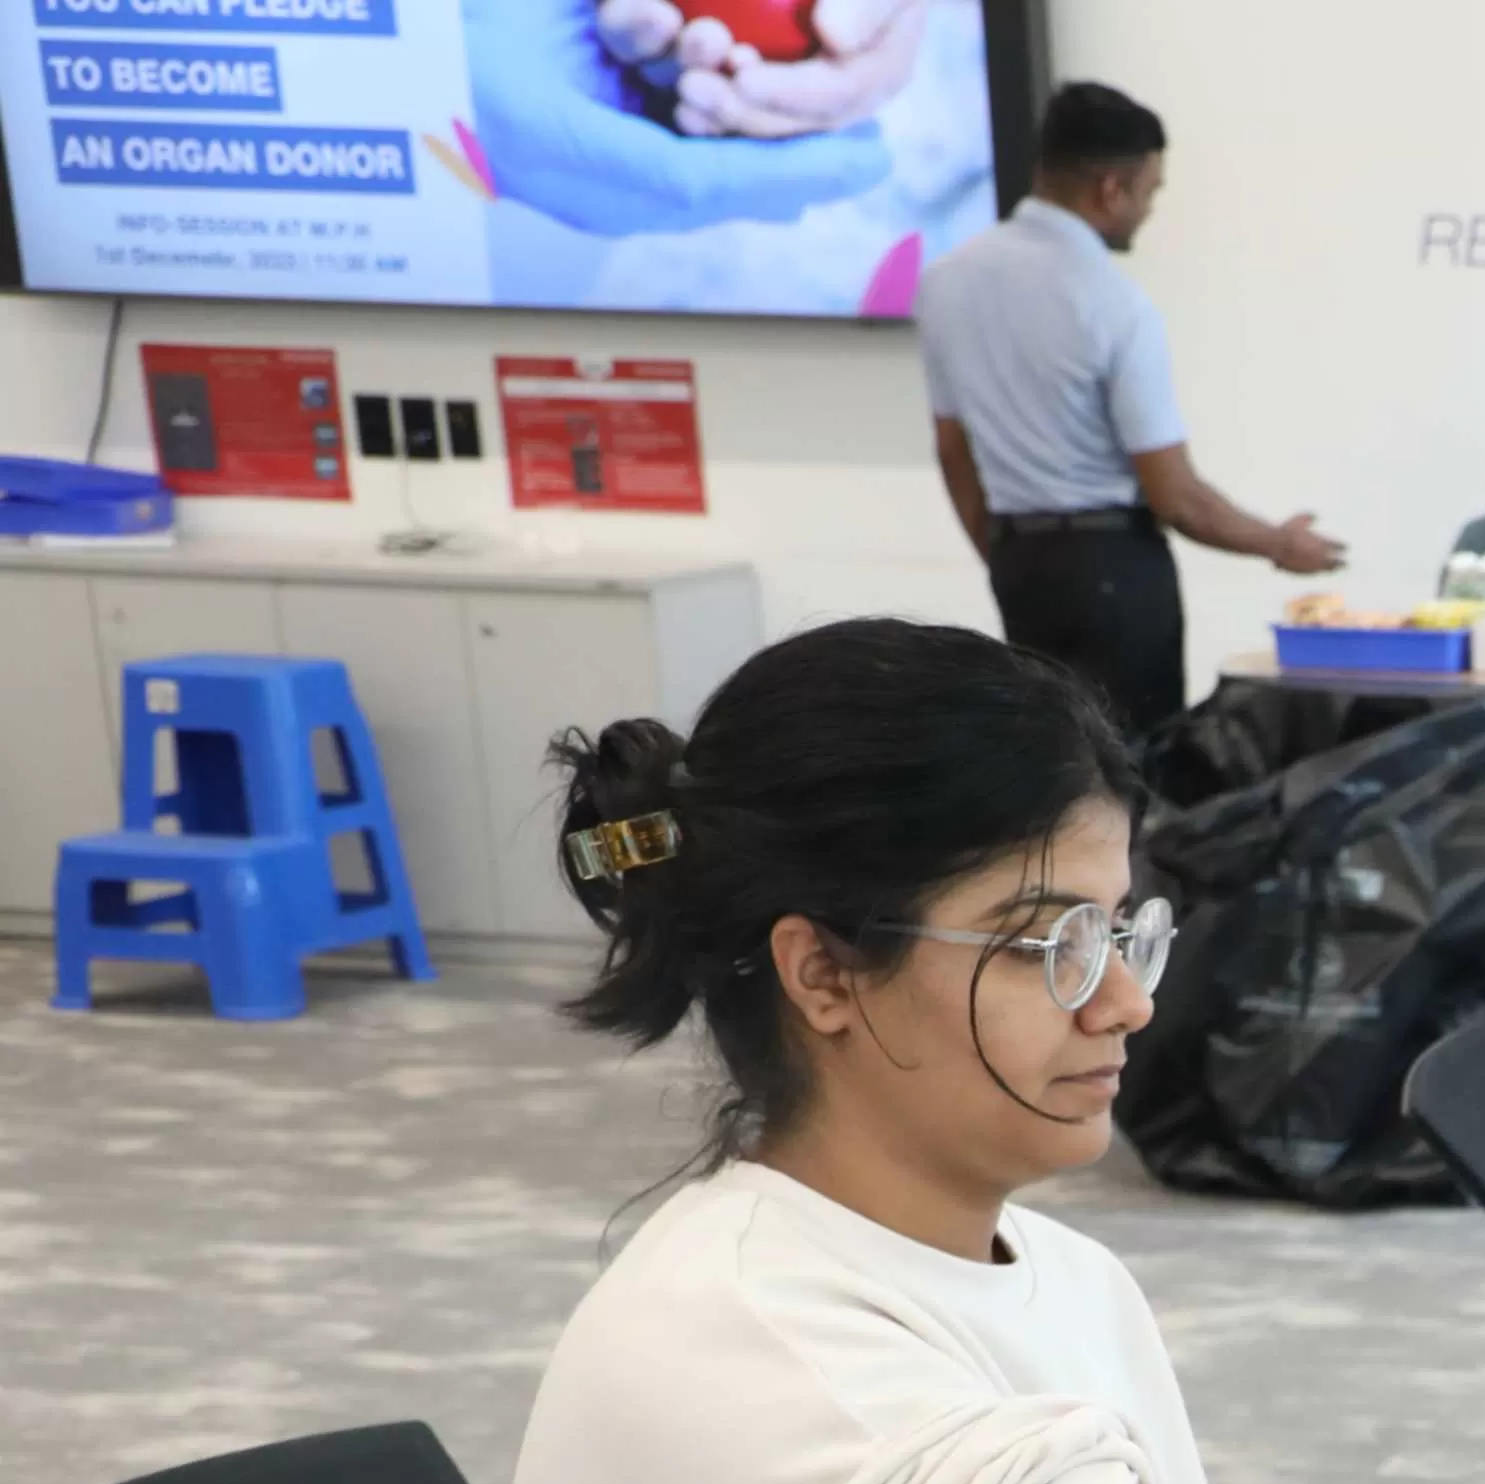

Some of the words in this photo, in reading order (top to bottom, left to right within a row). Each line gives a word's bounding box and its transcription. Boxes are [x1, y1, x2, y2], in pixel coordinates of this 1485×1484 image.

[47, 56, 101, 91] TO
[111, 58, 275, 97] BECOME
[61, 136, 114, 170] AN
[122, 137, 257, 174] ORGAN
[265, 140, 404, 180] DONOR
